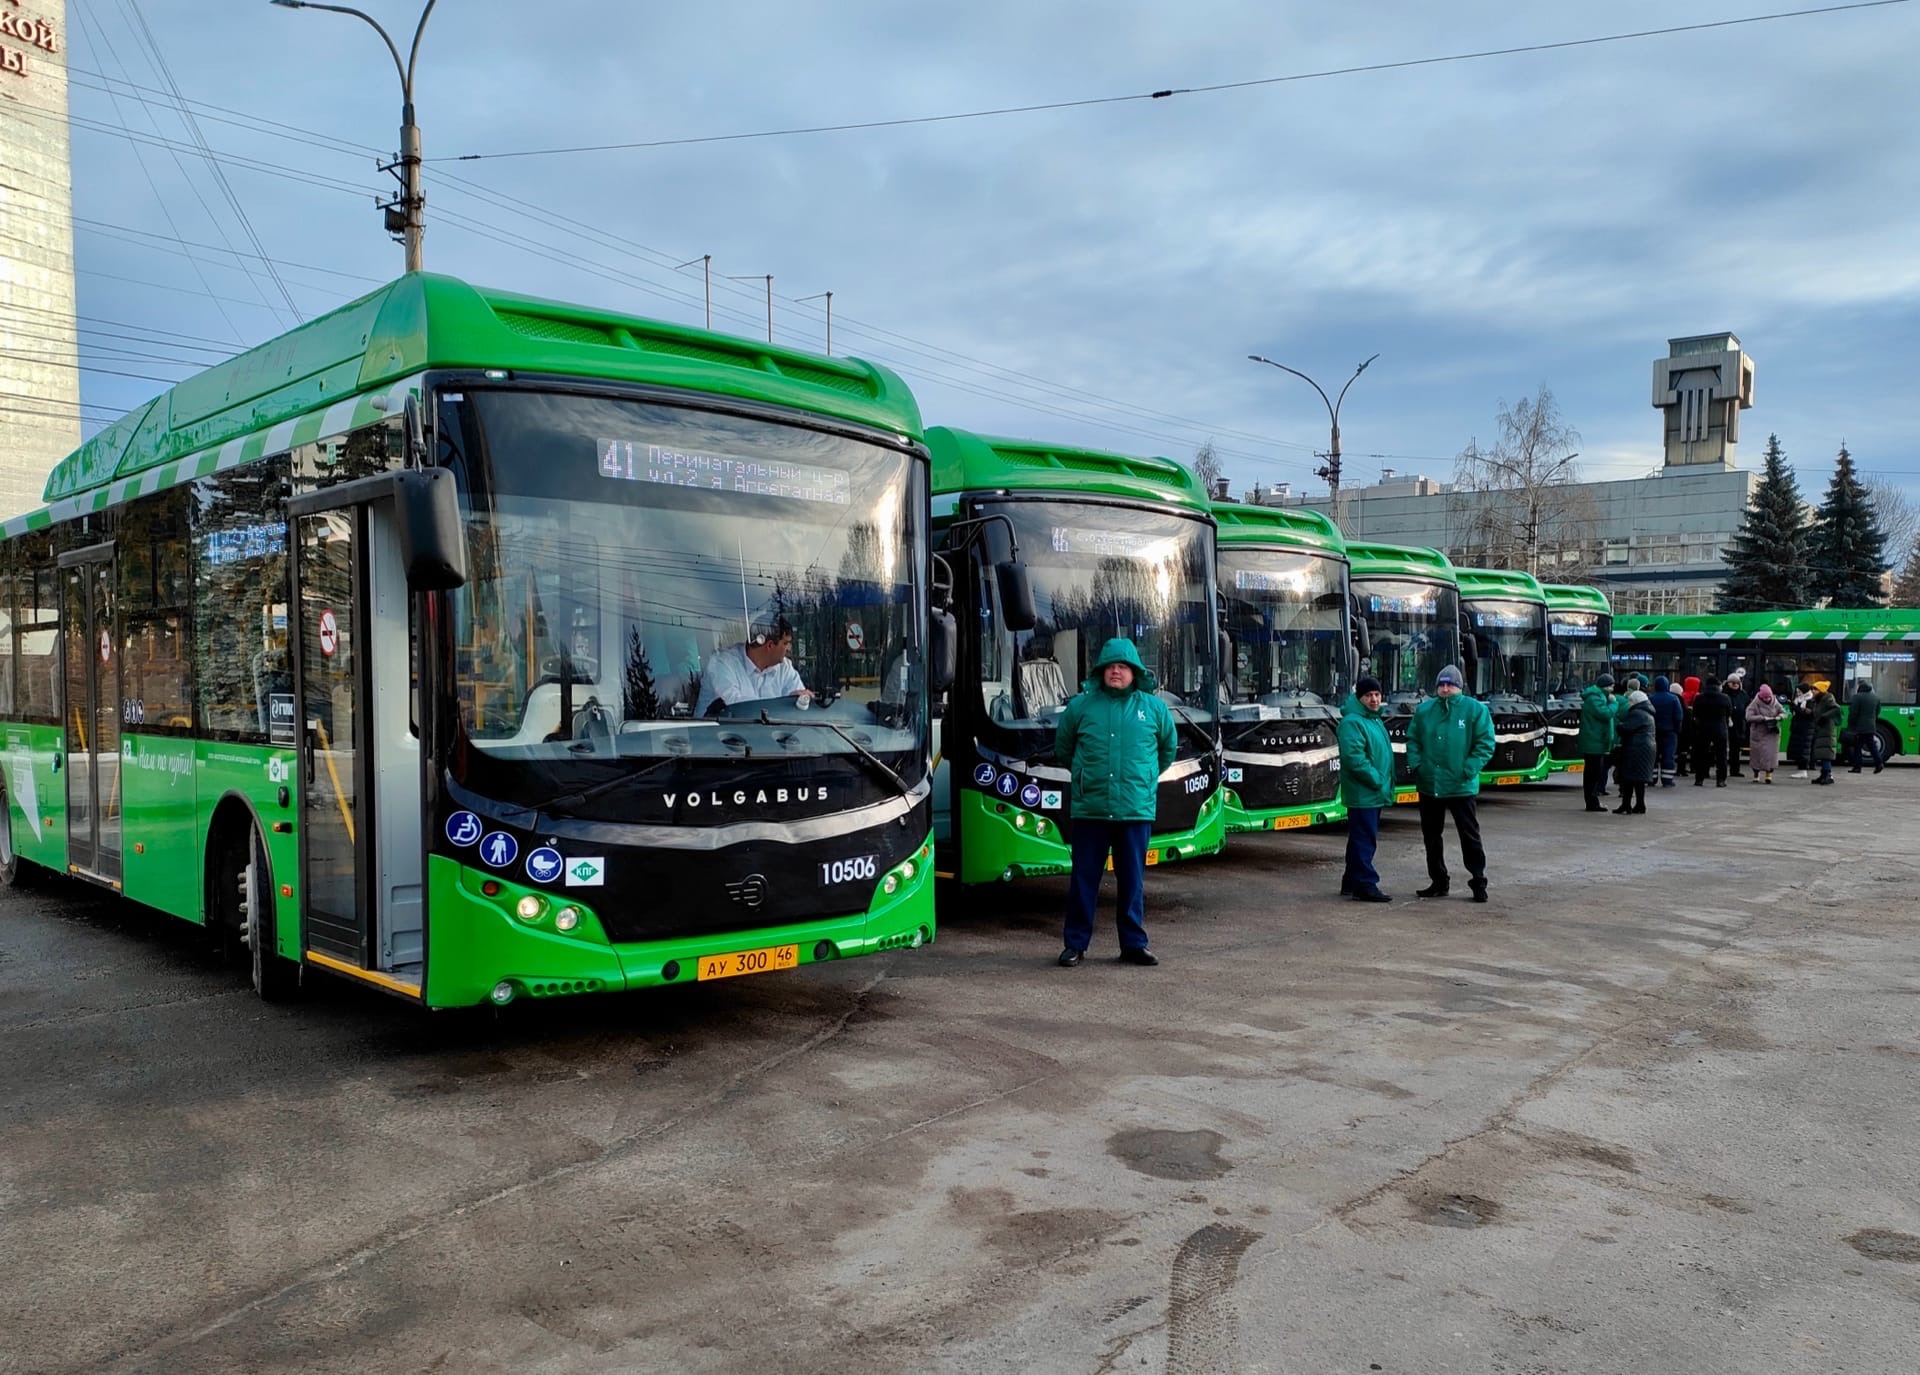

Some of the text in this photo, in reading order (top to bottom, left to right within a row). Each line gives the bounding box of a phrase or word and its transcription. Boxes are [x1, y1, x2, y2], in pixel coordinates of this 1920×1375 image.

[603, 440, 635, 481] 41
[648, 446, 801, 481] Перинатальный
[1262, 735, 1322, 746] VOLGABUS
[1329, 758, 1341, 772] 105
[1184, 774, 1209, 794] 10509
[662, 787, 828, 809] VOLGABUS
[576, 867, 593, 877] КПГ
[822, 854, 877, 885] 10506
[736, 951, 767, 972] 300
[777, 946, 793, 961] 46
